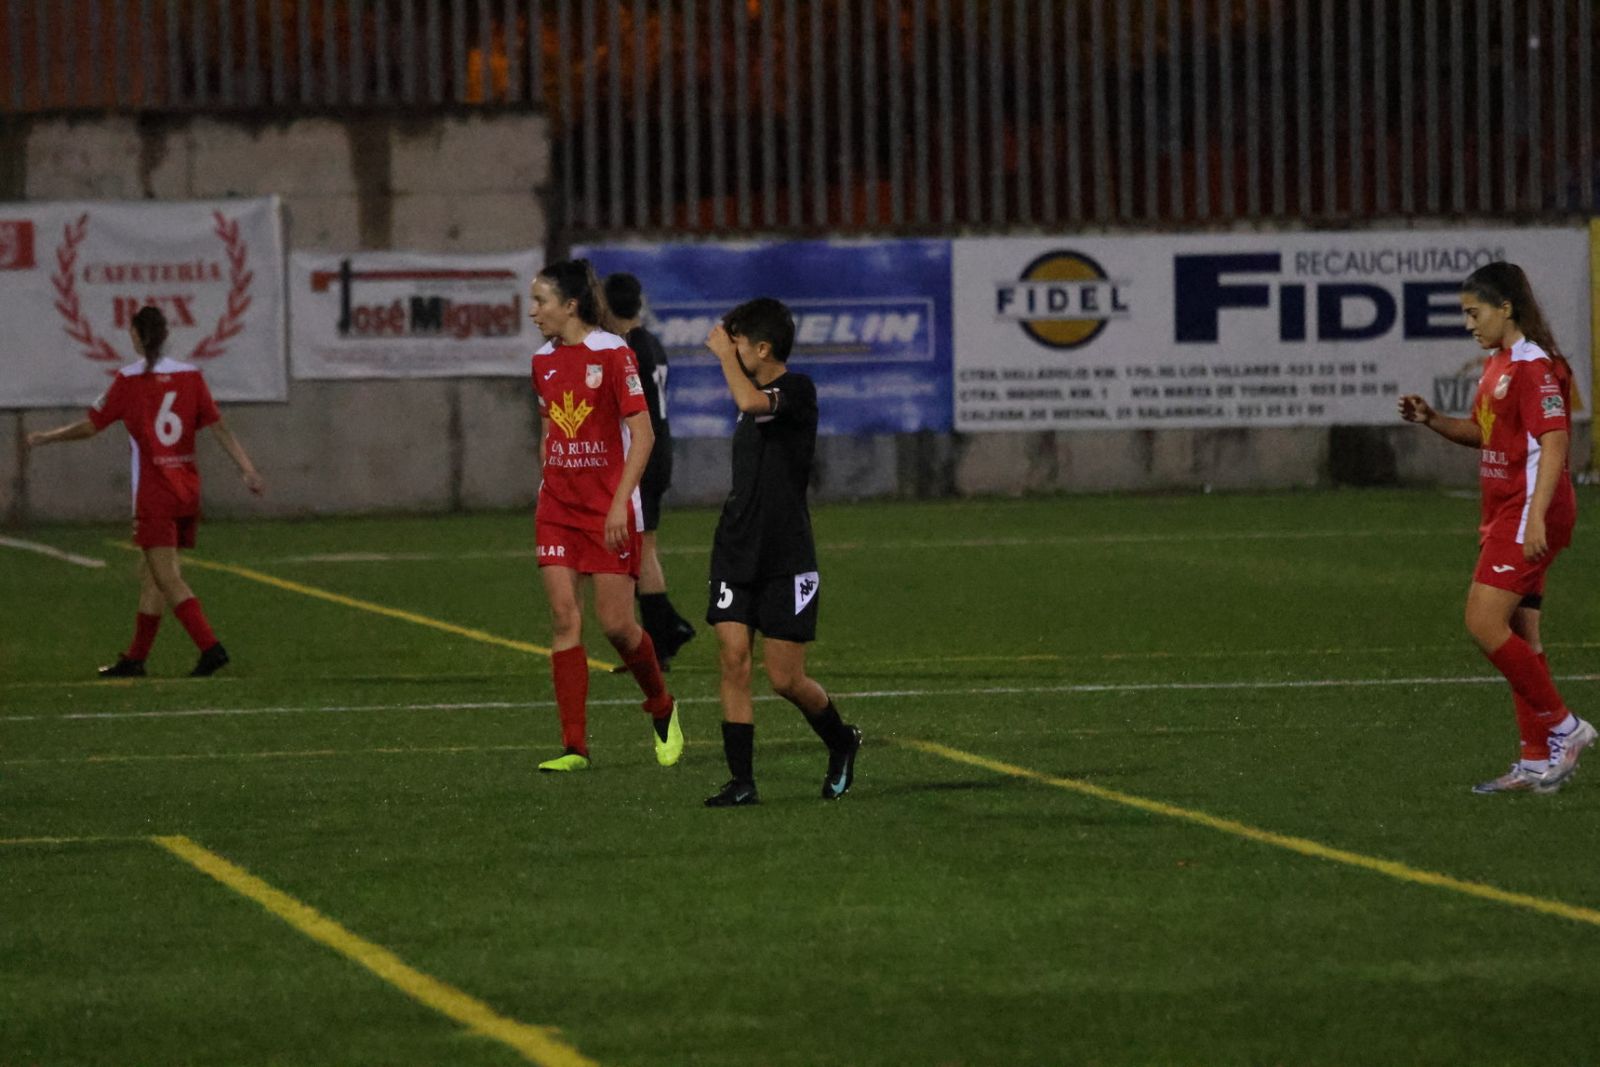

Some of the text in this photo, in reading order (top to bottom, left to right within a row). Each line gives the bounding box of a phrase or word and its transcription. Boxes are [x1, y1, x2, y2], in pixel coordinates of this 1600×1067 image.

[997, 286, 1129, 314] FIDEL
[1174, 252, 1474, 343] FIDE
[661, 312, 920, 346] MELIN
[155, 391, 183, 446] 6
[568, 440, 608, 455] RURAL
[716, 580, 733, 609] 5
